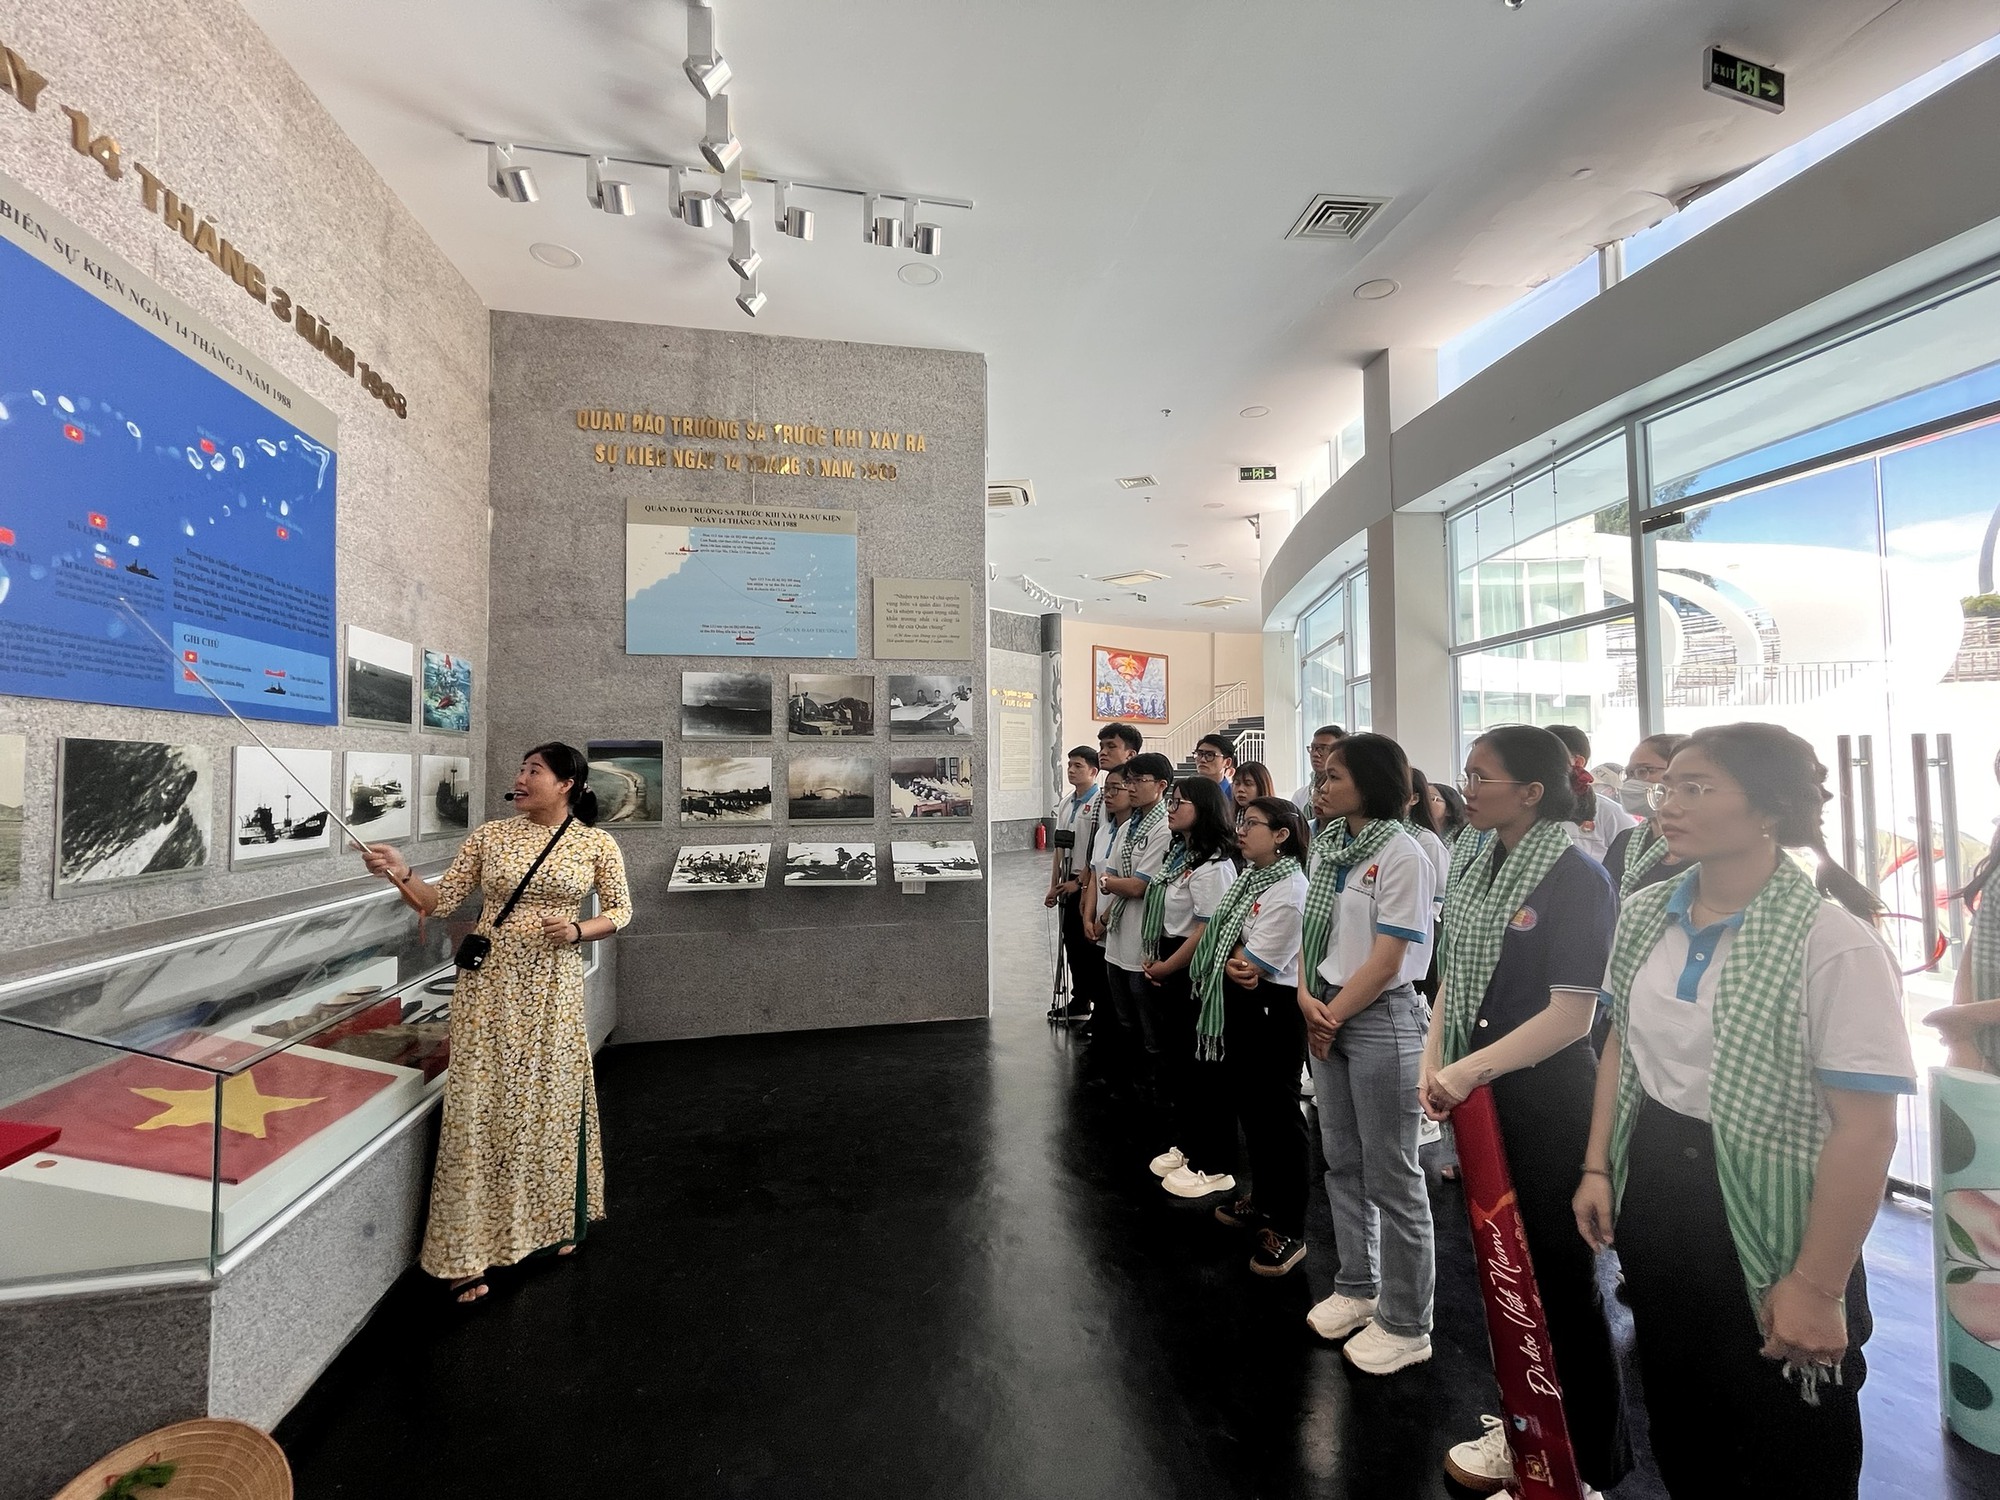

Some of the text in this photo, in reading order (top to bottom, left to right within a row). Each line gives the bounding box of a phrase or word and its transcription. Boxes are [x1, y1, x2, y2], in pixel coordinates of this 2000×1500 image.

[1713, 62, 1736, 80] EXIT
[60, 104, 123, 181] 14
[271, 286, 291, 323] 3
[357, 361, 407, 420] 1988
[53, 236, 80, 265] SỰ
[129, 288, 171, 326] NGÀY
[175, 320, 188, 339] 14
[190, 330, 235, 371] THÁNG
[236, 363, 243, 376] 3
[246, 368, 270, 395] NĂM
[272, 388, 292, 409] 1988
[746, 422, 767, 443] SA
[833, 428, 863, 449] KHI
[905, 432, 927, 453] RA
[724, 453, 742, 472] 14
[694, 515, 717, 524] NGÀY
[727, 516, 755, 526] THÁNG
[762, 518, 781, 527] NĂM
[782, 520, 798, 528] 1988
[724, 508, 735, 516] SA
[1484, 1218, 1523, 1286] Nam
[1495, 1286, 1537, 1328] Việt
[1519, 1333, 1542, 1362] dọc
[1526, 1364, 1562, 1401] Đi
